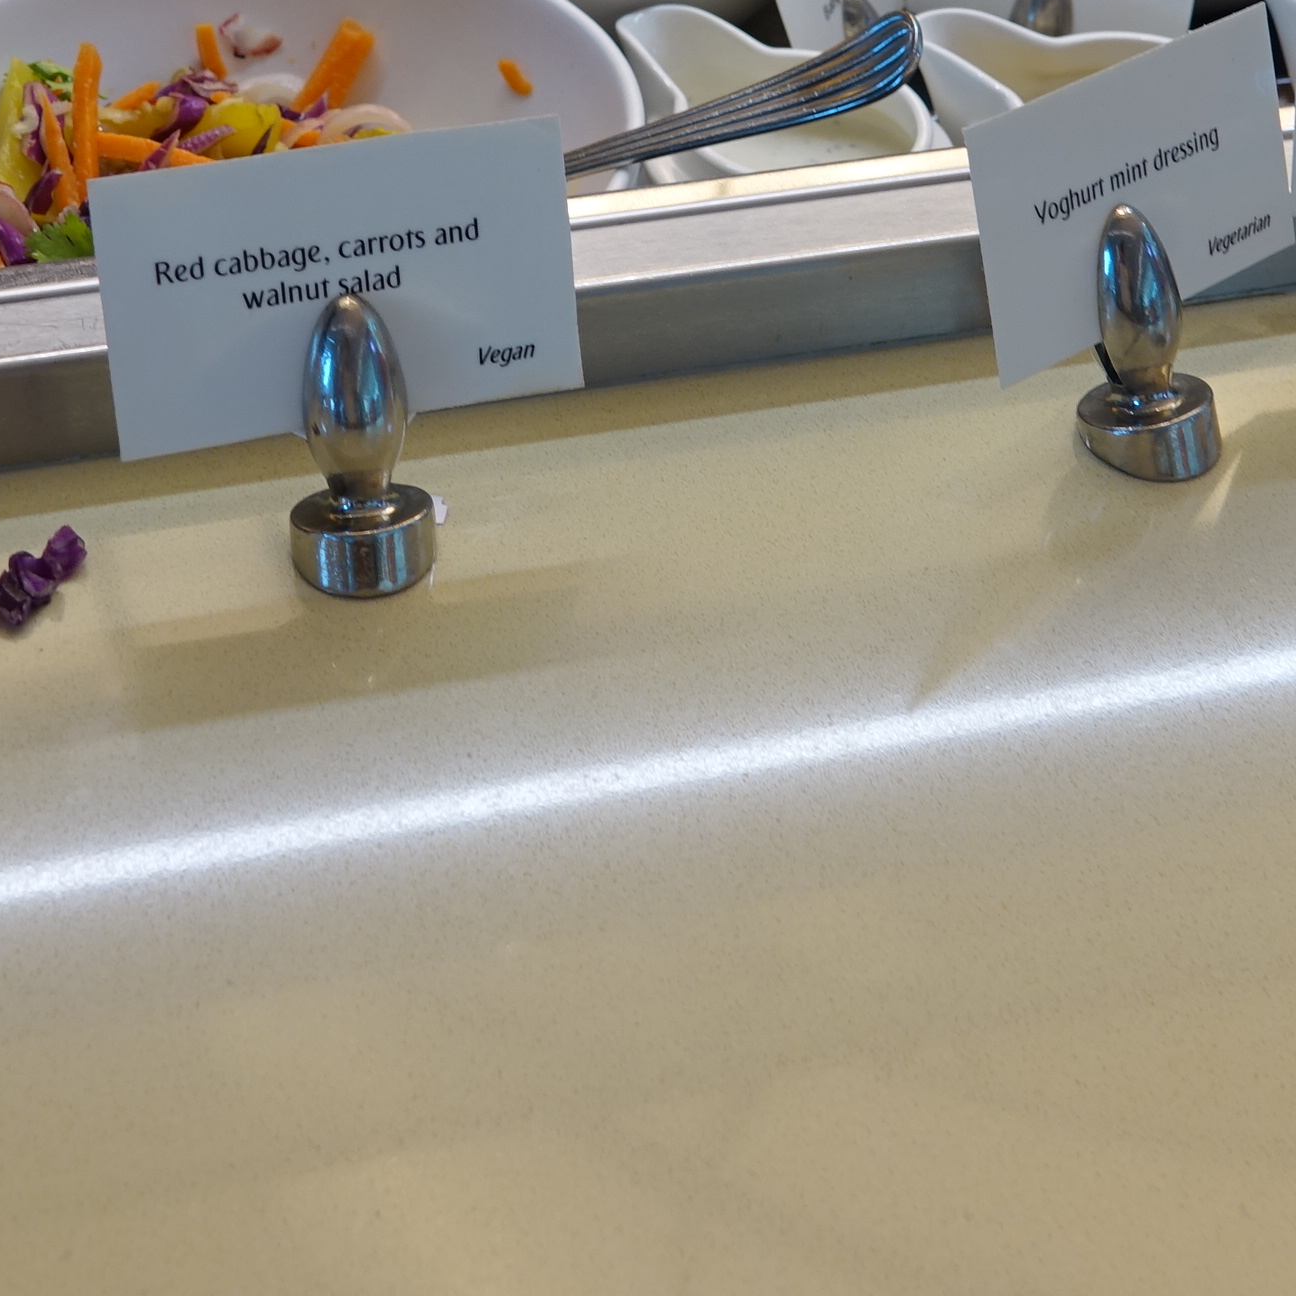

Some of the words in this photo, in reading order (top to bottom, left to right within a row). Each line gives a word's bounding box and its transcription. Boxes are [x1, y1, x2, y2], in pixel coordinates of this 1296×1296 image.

[1033, 176, 1106, 226] Yoghurt
[1108, 156, 1150, 194] mint
[1152, 125, 1221, 172] dressing
[154, 255, 205, 286] Red
[213, 244, 331, 277] cabbage,
[337, 227, 427, 259] carrots
[434, 216, 481, 246] and
[1206, 212, 1272, 257] Vegetarian
[241, 278, 331, 311] walnut
[337, 264, 402, 296] salad
[477, 340, 537, 368] Vegan
